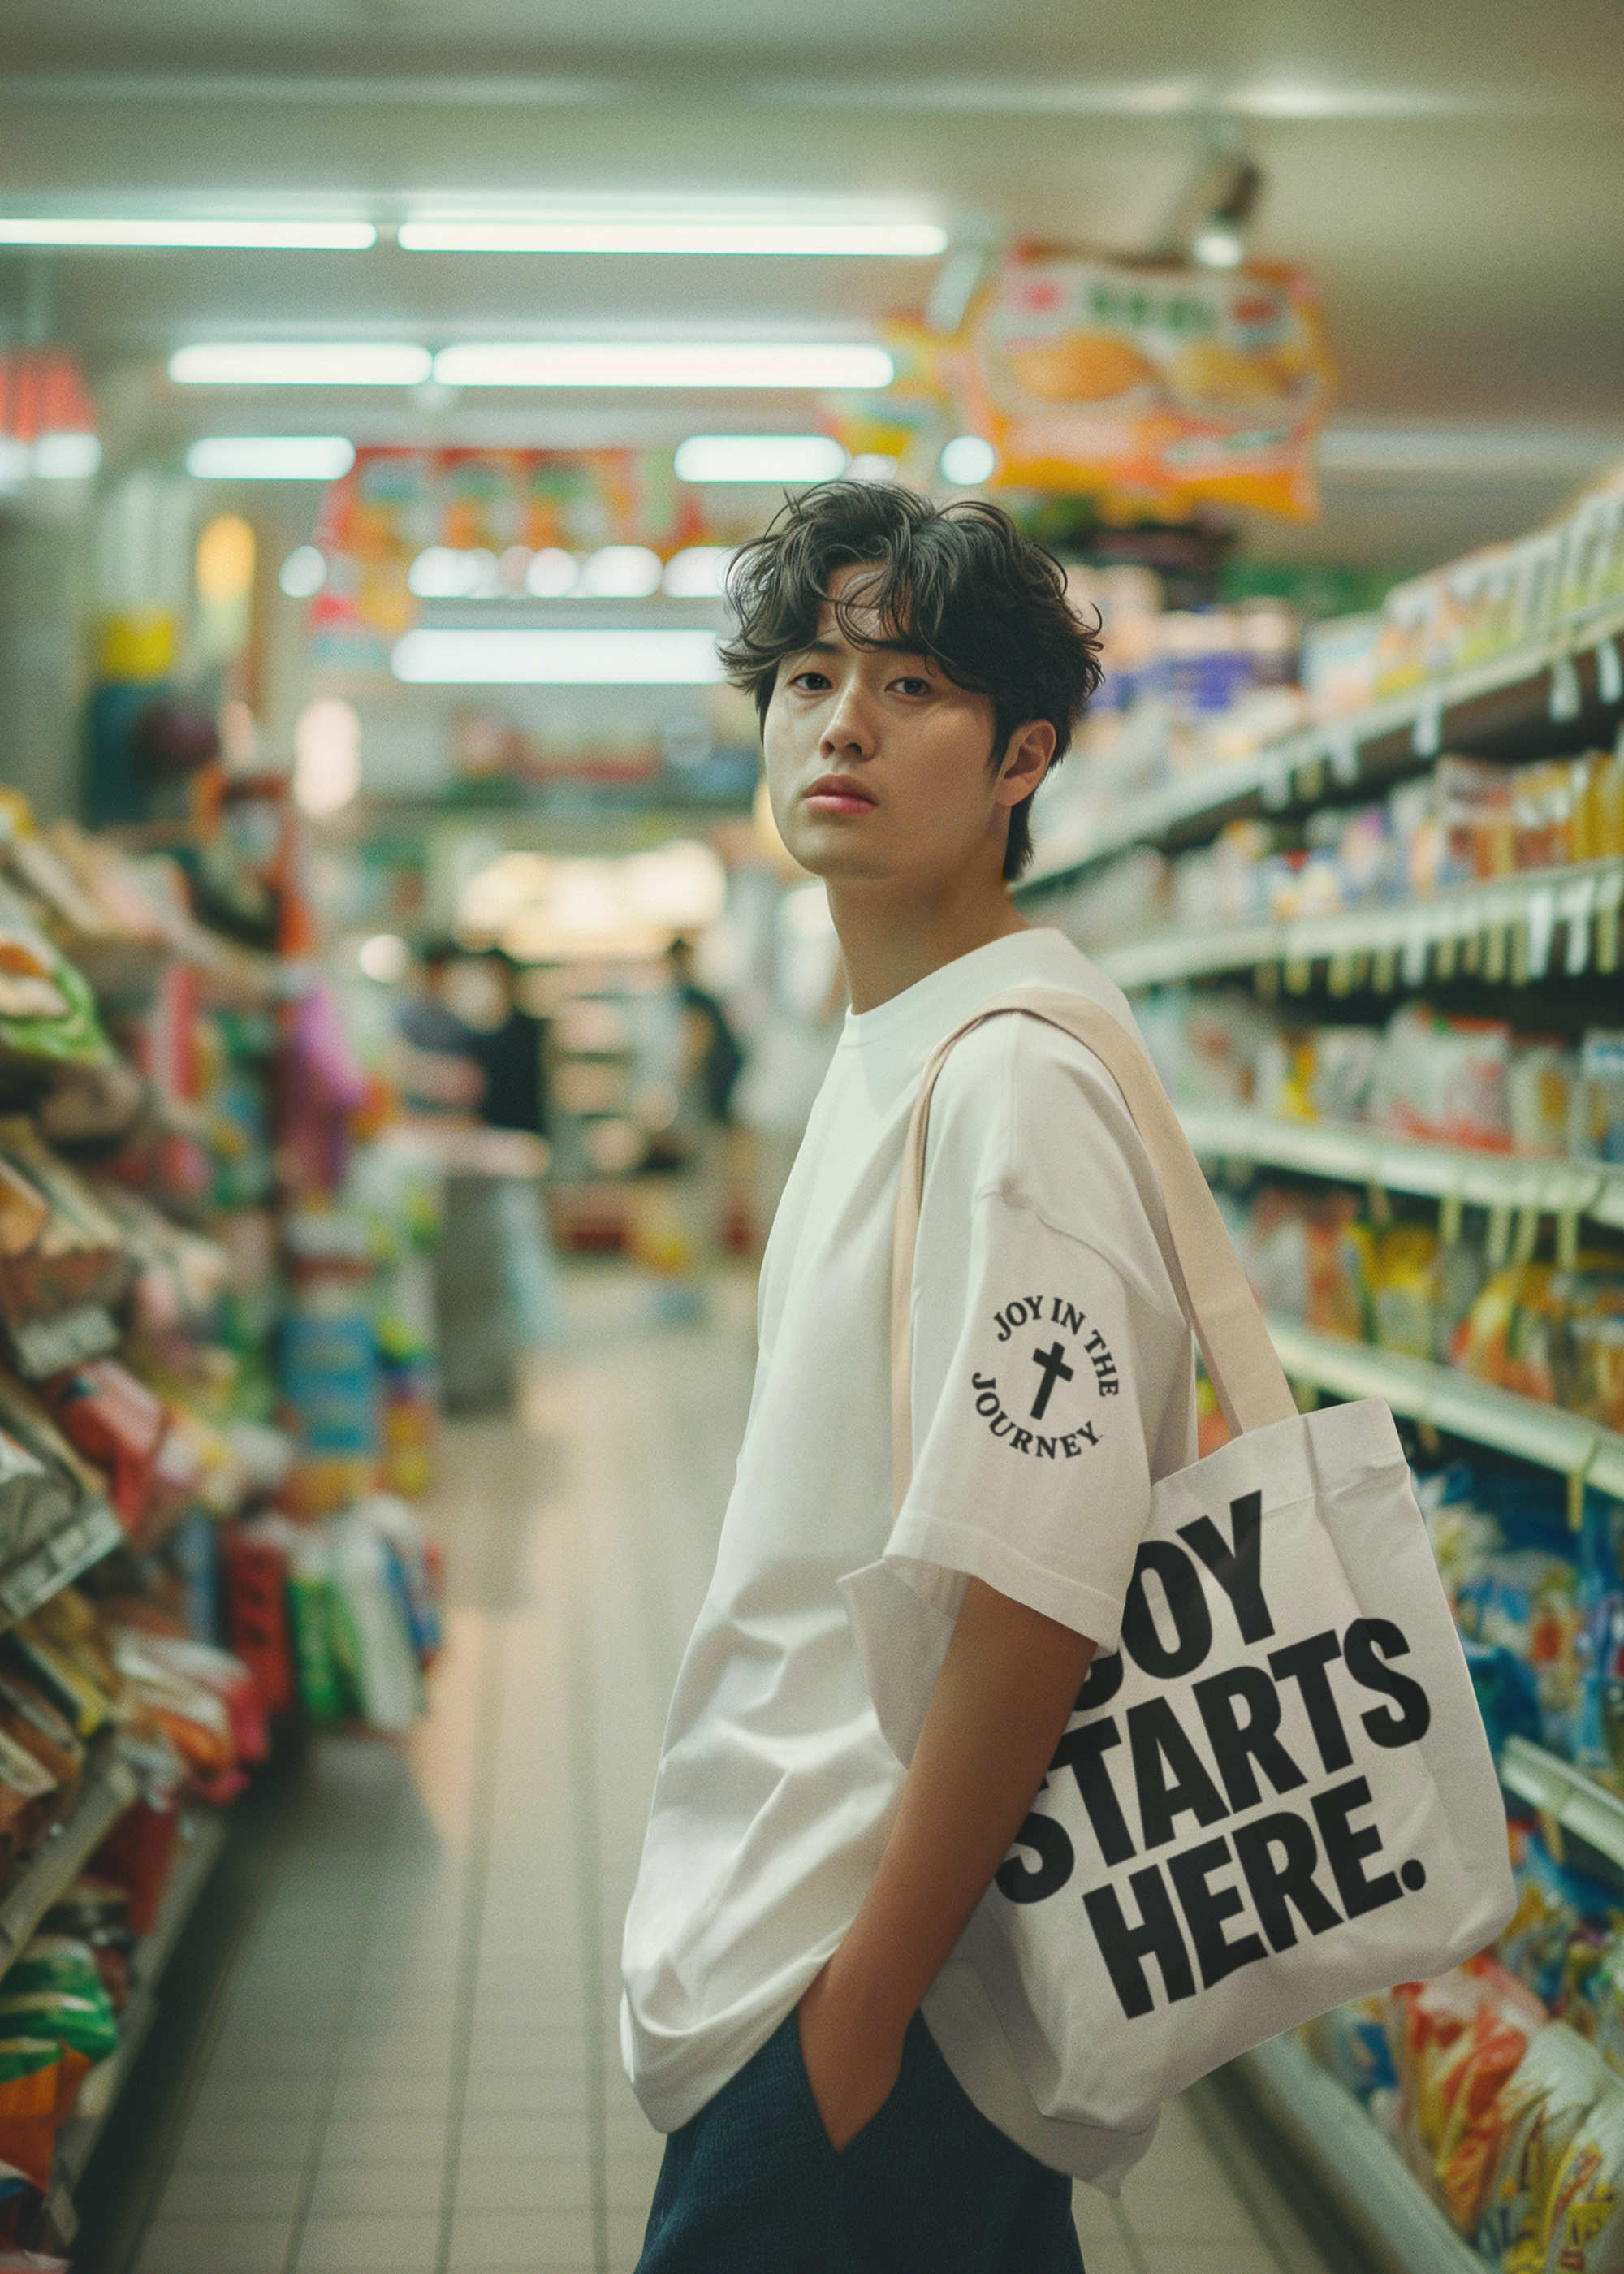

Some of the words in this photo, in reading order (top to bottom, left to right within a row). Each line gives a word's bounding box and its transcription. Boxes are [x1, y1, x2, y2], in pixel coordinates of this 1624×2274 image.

[993, 1295, 1044, 1342] JOY
[1050, 1296, 1086, 1336] IN
[1084, 1329, 1119, 1397] THE
[971, 1372, 1100, 1459] JOURNEY
[1082, 1775, 1427, 2021] HERE.
